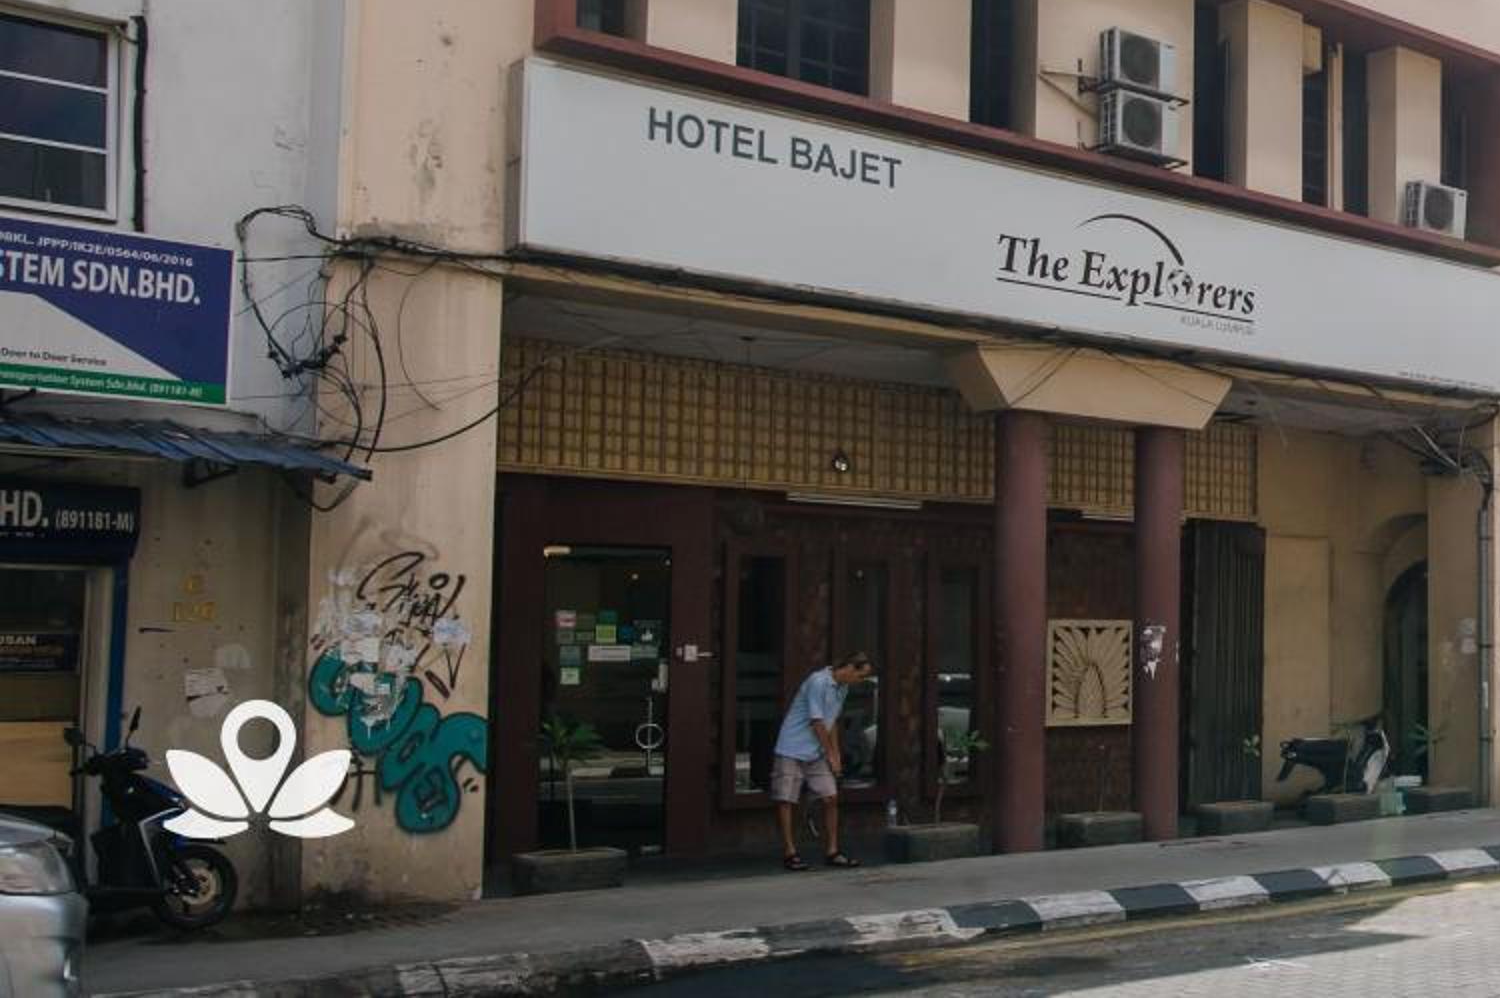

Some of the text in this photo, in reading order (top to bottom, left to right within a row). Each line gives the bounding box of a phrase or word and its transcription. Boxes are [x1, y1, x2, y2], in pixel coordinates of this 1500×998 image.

[648, 107, 902, 189] HOTEL BAJET
[72, 259, 201, 305] SDN.BHD.
[998, 233, 1255, 315] The Explorers
[56, 508, 134, 534] (891181-M)
